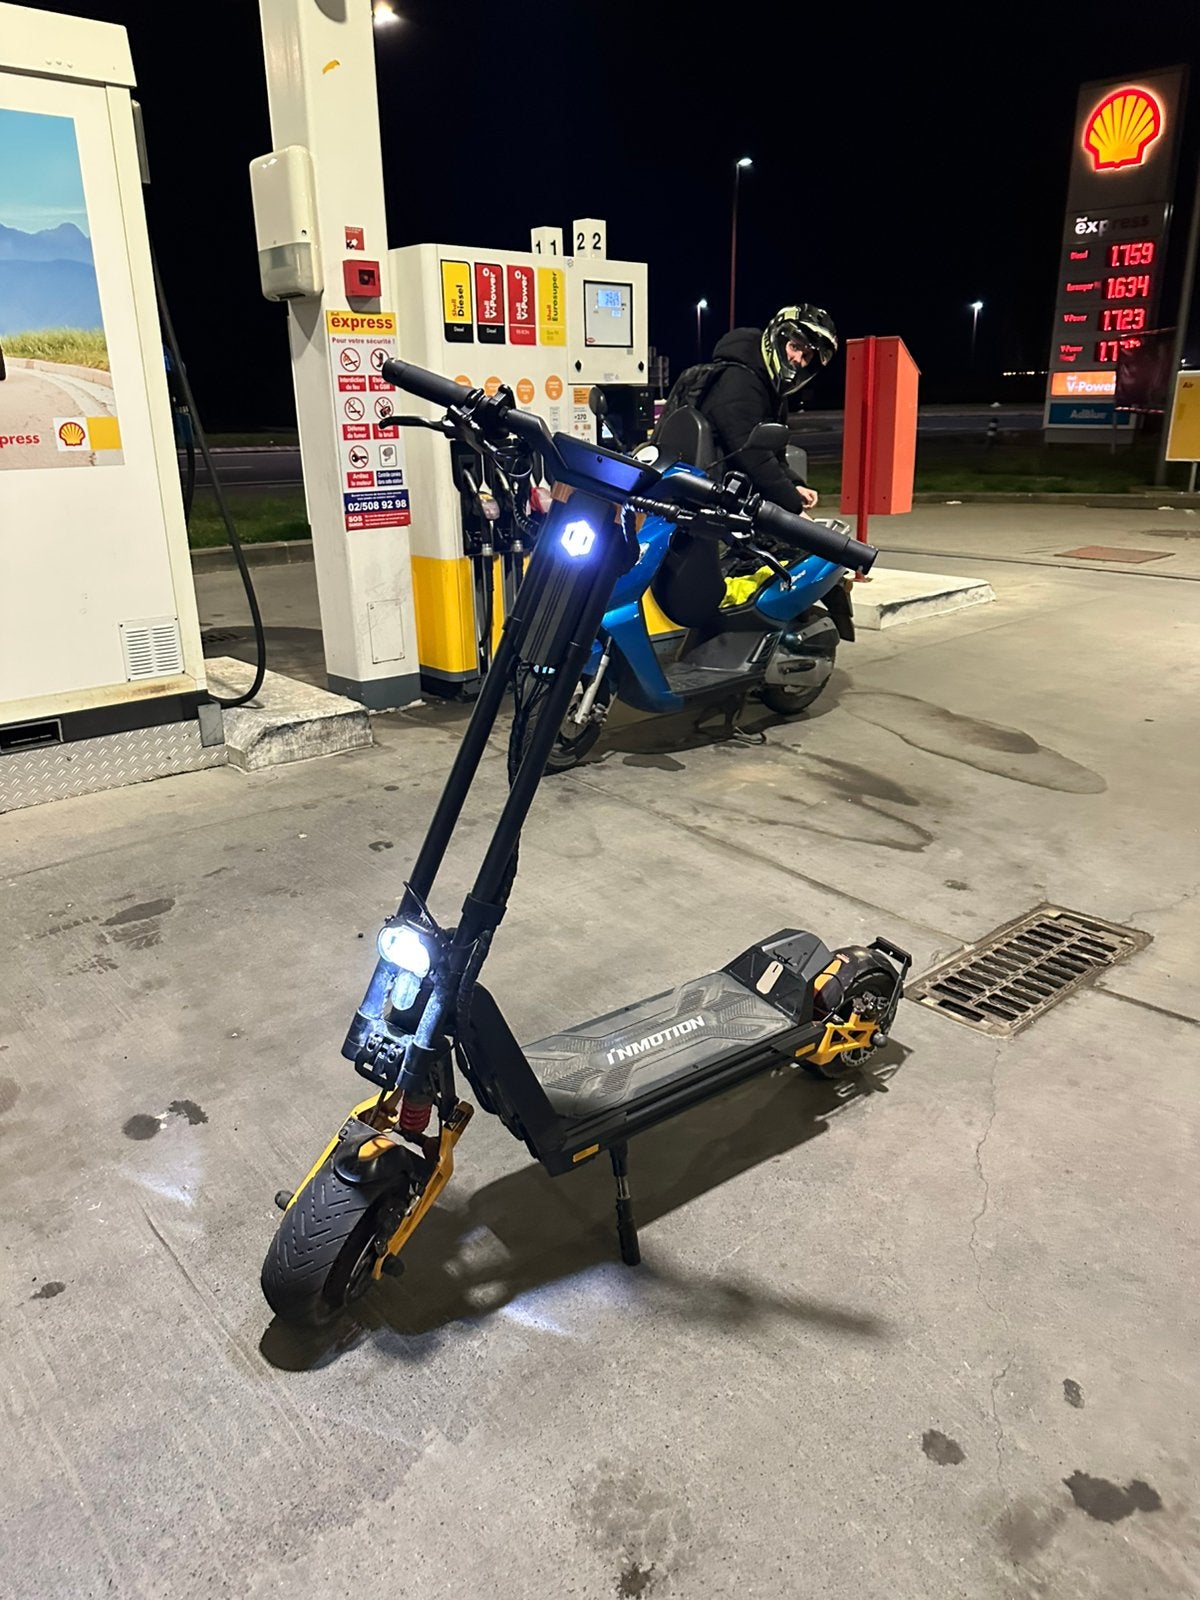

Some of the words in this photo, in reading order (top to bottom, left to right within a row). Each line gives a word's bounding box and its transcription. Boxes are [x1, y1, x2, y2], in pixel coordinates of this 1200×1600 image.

[535, 240, 542, 254] 1
[550, 239, 557, 255] 1
[577, 232, 585, 250] 2
[592, 232, 601, 250] 2
[456, 284, 465, 317] Diesel
[489, 271, 497, 319] V-Power
[520, 274, 529, 320] V-Power
[551, 271, 560, 322] Eurosuper
[331, 316, 393, 331] express
[1103, 308, 1145, 331] 1.723
[347, 501, 380, 512] 02/508
[381, 500, 393, 509] 92
[395, 499, 407, 509] 98
[606, 1015, 706, 1065] INMOTION
